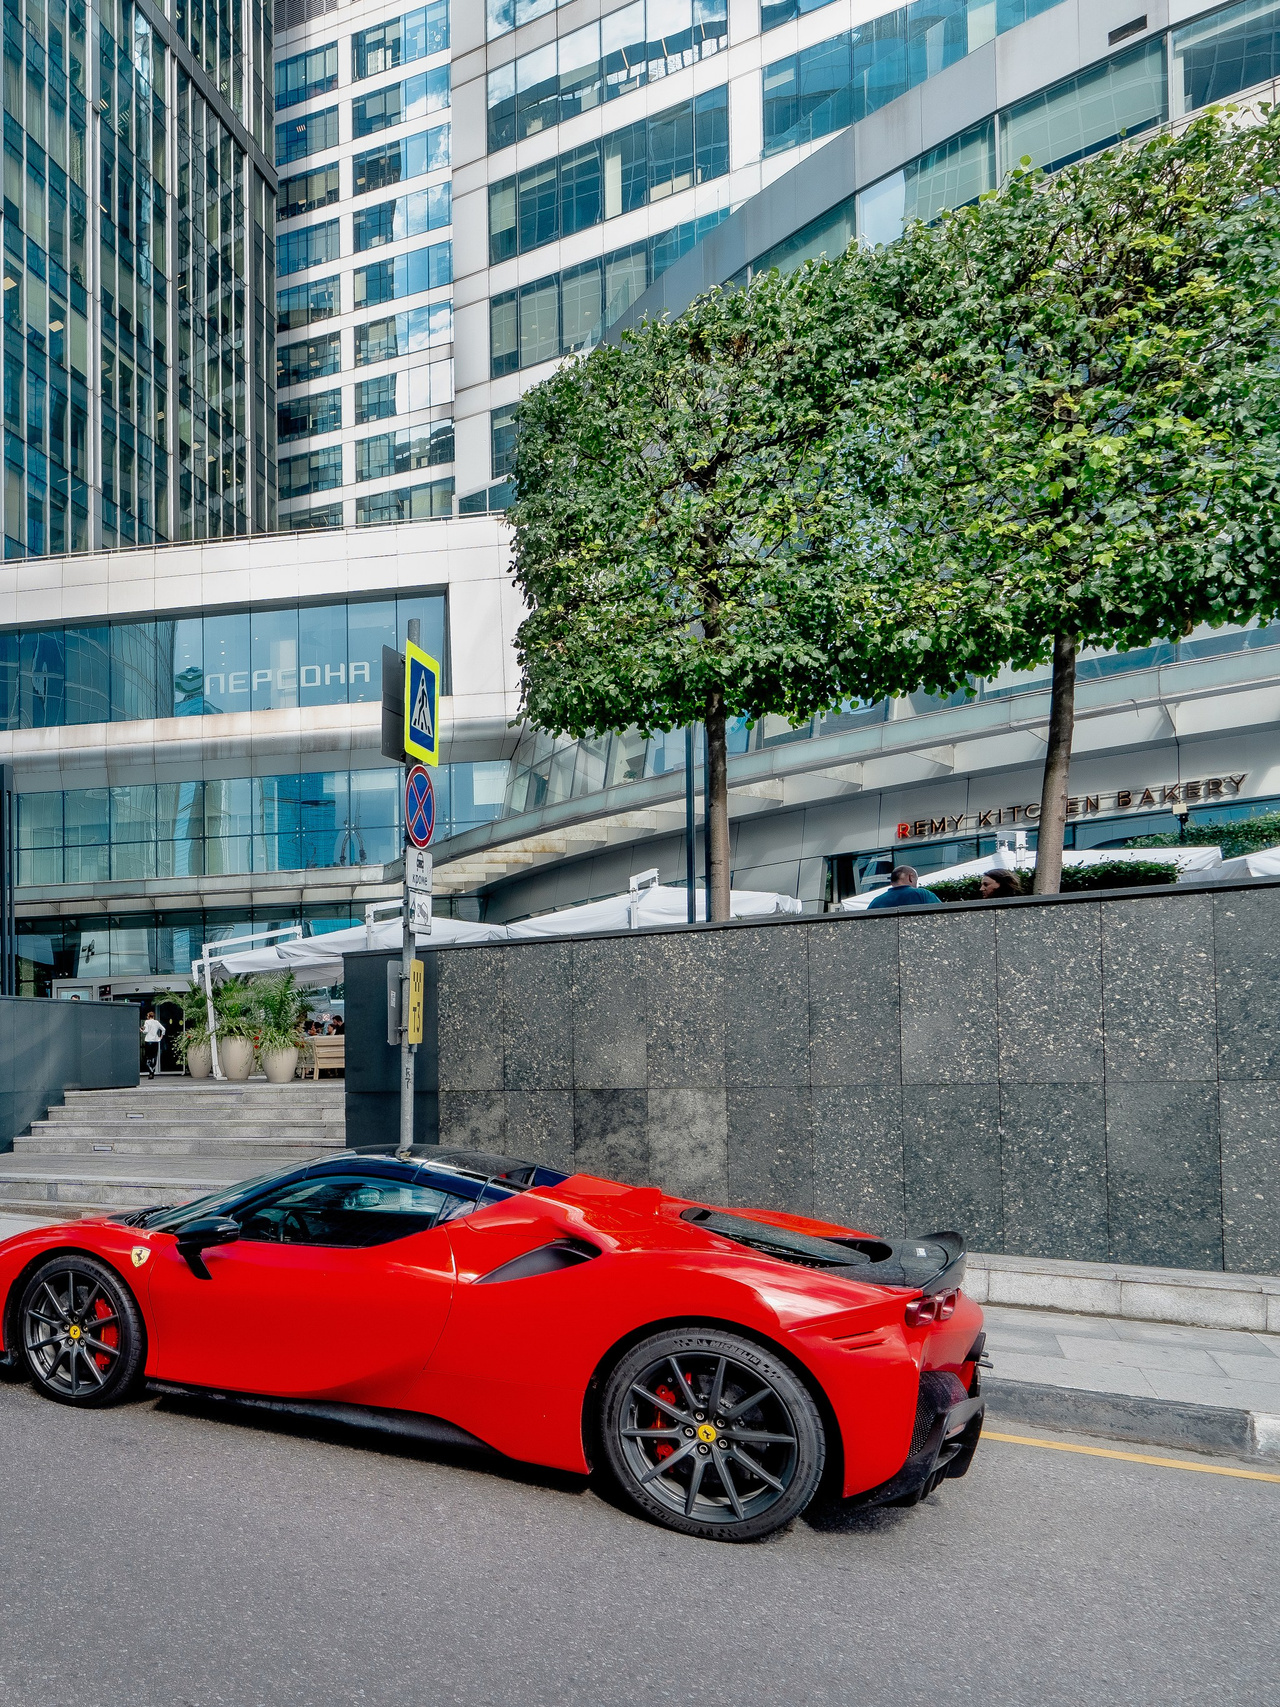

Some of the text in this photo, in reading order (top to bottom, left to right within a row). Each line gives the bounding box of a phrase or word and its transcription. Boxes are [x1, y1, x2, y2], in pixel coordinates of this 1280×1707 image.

[205, 661, 370, 695] ПЕРСОНА
[897, 773, 1248, 839] REMY KITCEN BAKERY
[709, 1340, 761, 1366] MICHELIN
